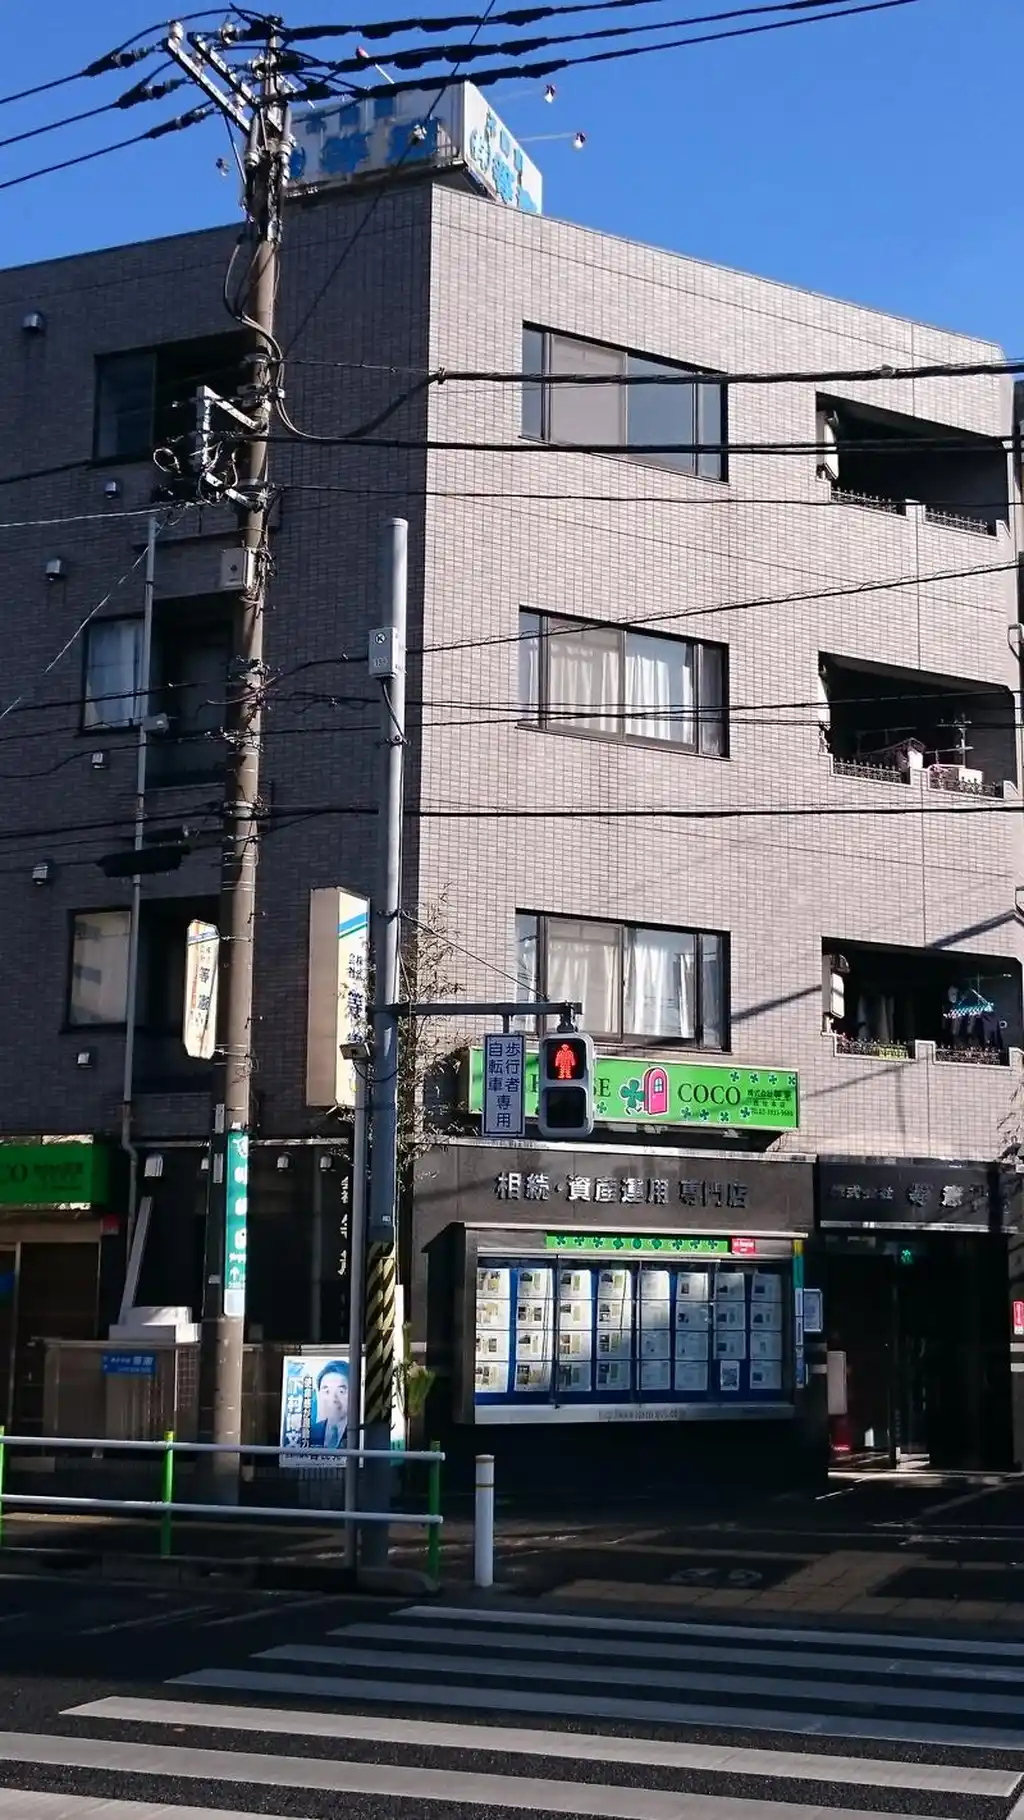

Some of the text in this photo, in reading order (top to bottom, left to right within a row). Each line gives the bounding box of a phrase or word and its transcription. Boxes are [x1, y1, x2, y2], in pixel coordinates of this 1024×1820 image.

[488, 1042, 503, 1092] 自転車
[505, 1042, 521, 1092] 歩行者
[496, 1094, 512, 1128] 専用
[677, 1083, 741, 1106] COCO
